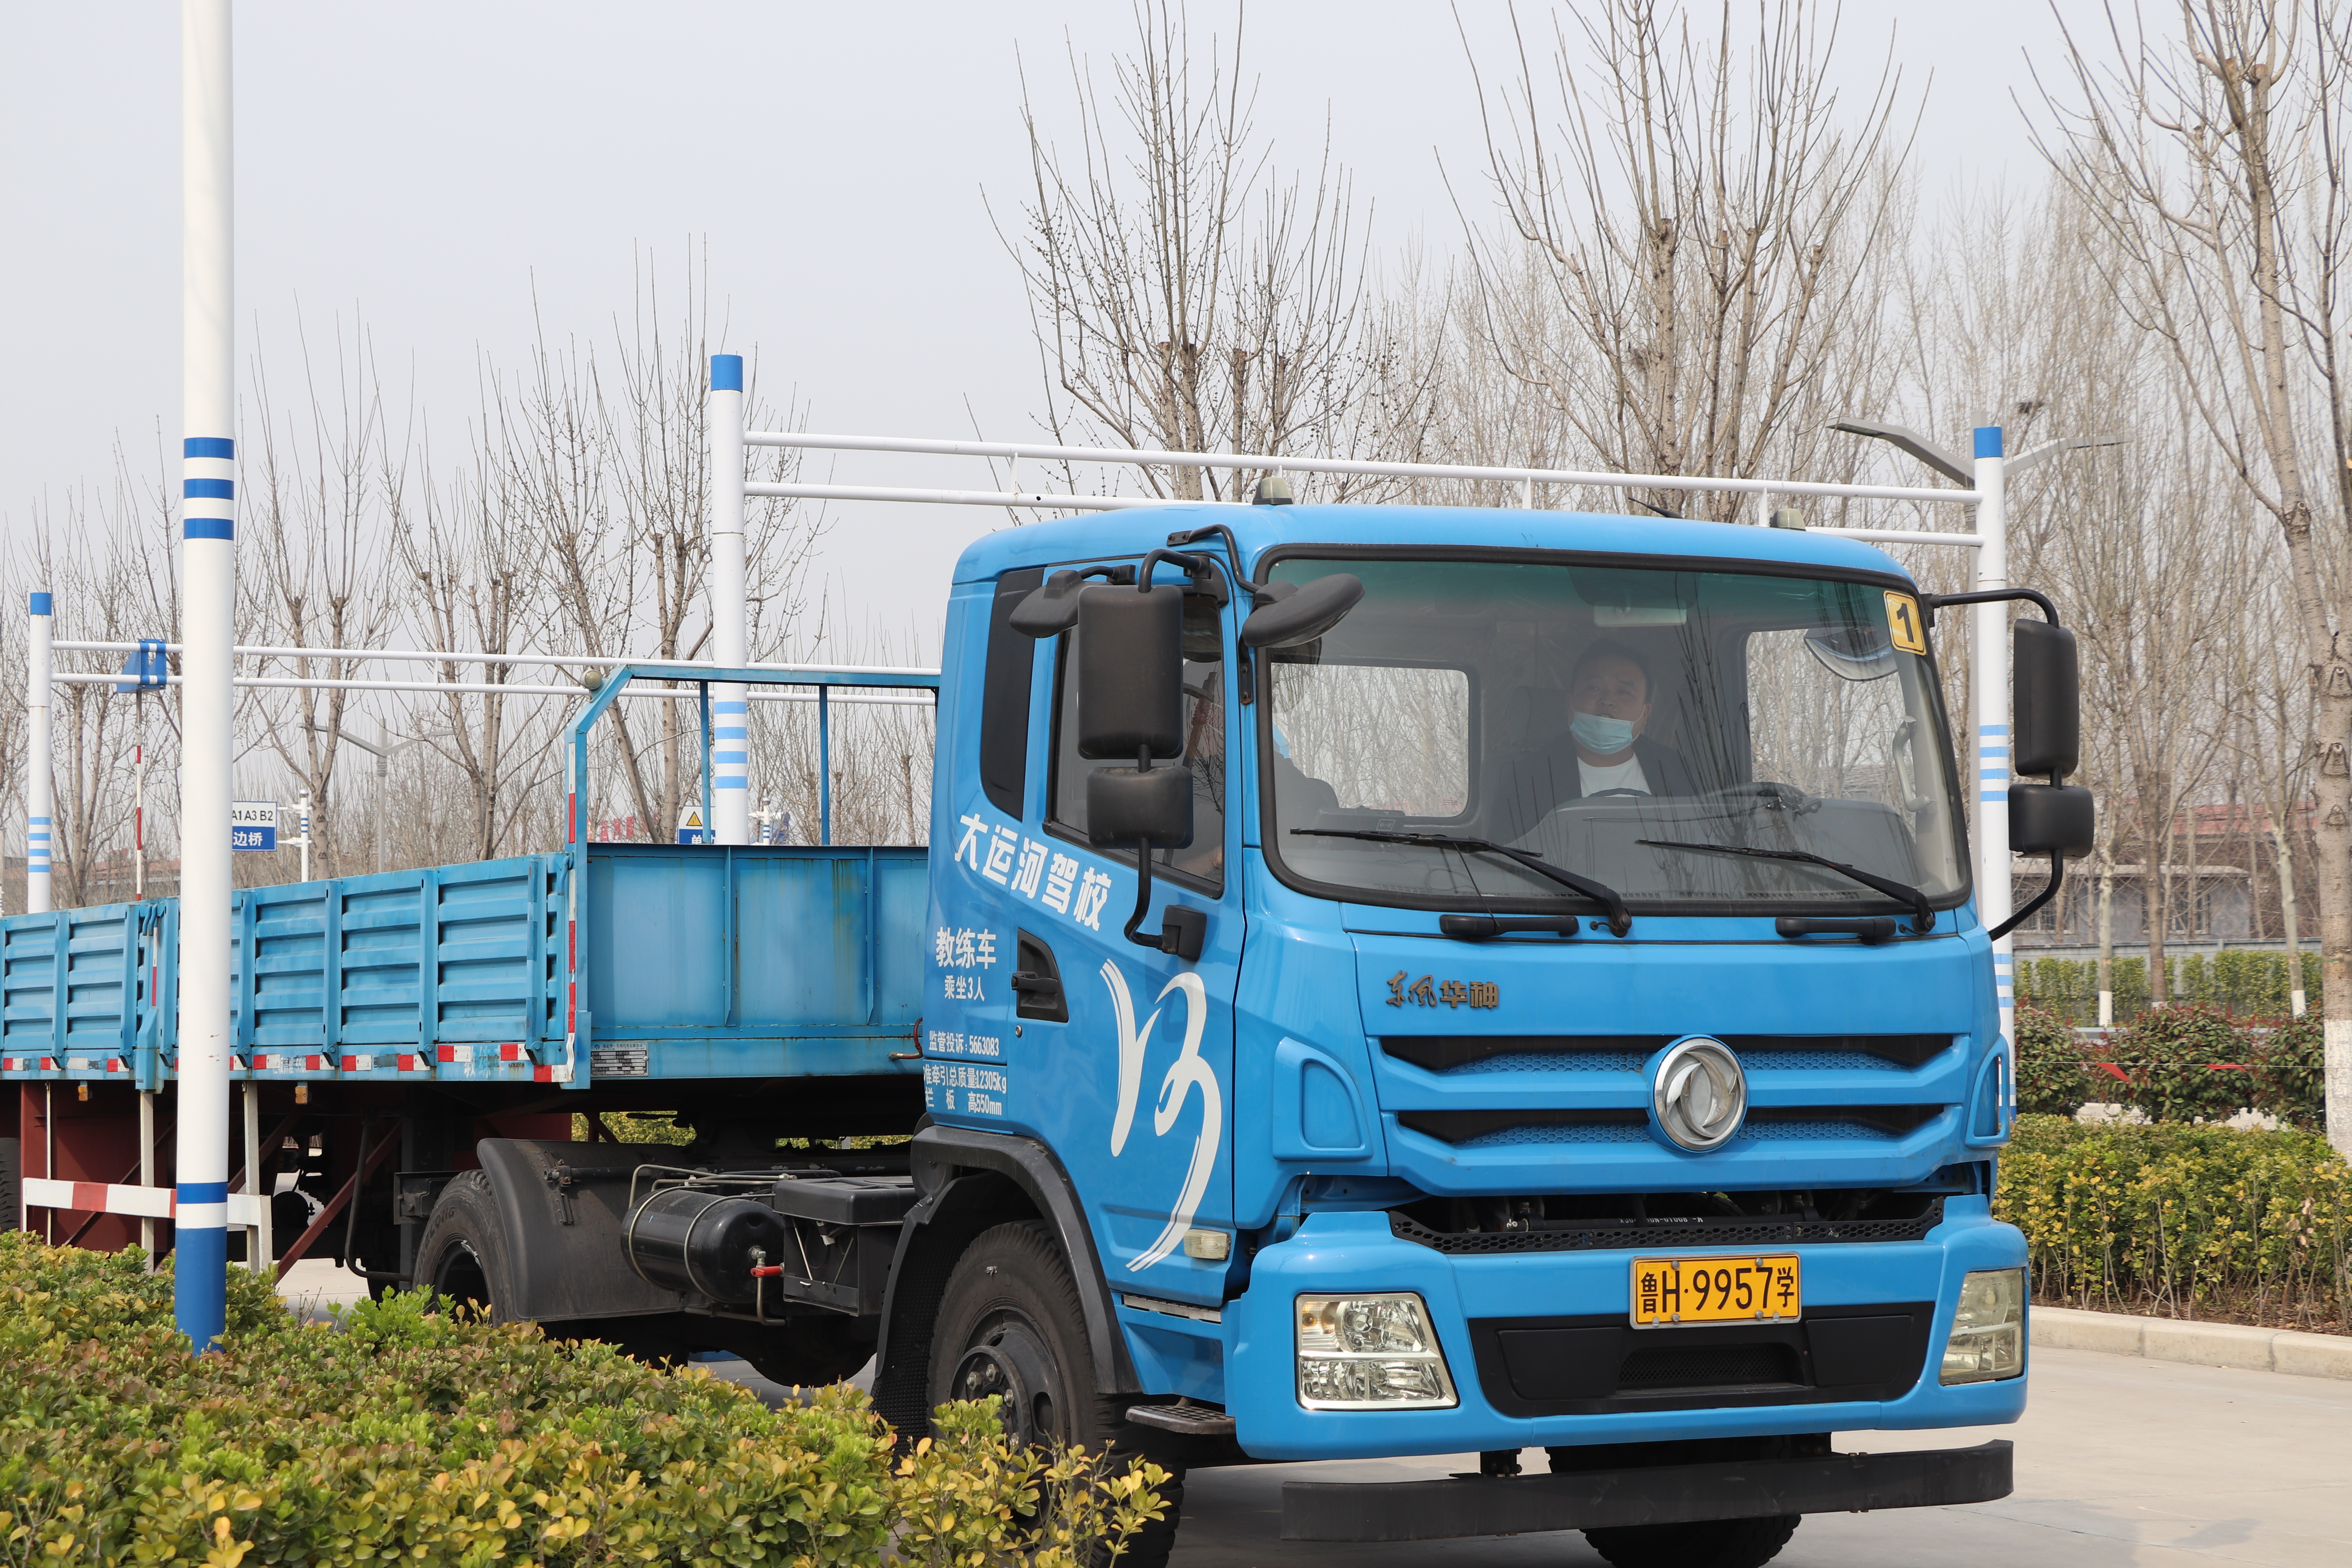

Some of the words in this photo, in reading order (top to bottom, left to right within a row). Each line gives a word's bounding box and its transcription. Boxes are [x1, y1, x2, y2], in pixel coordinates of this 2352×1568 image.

[1896, 603, 1914, 643] 1
[232, 810, 242, 820] A1
[244, 810, 257, 820] A3
[260, 810, 273, 821] B2
[233, 831, 263, 846] 边桥
[955, 813, 1112, 931] 大运河驾校
[936, 927, 996, 969] 教练车
[944, 975, 985, 1002] 乘坐3人
[1387, 970, 1499, 1009] 东风华神
